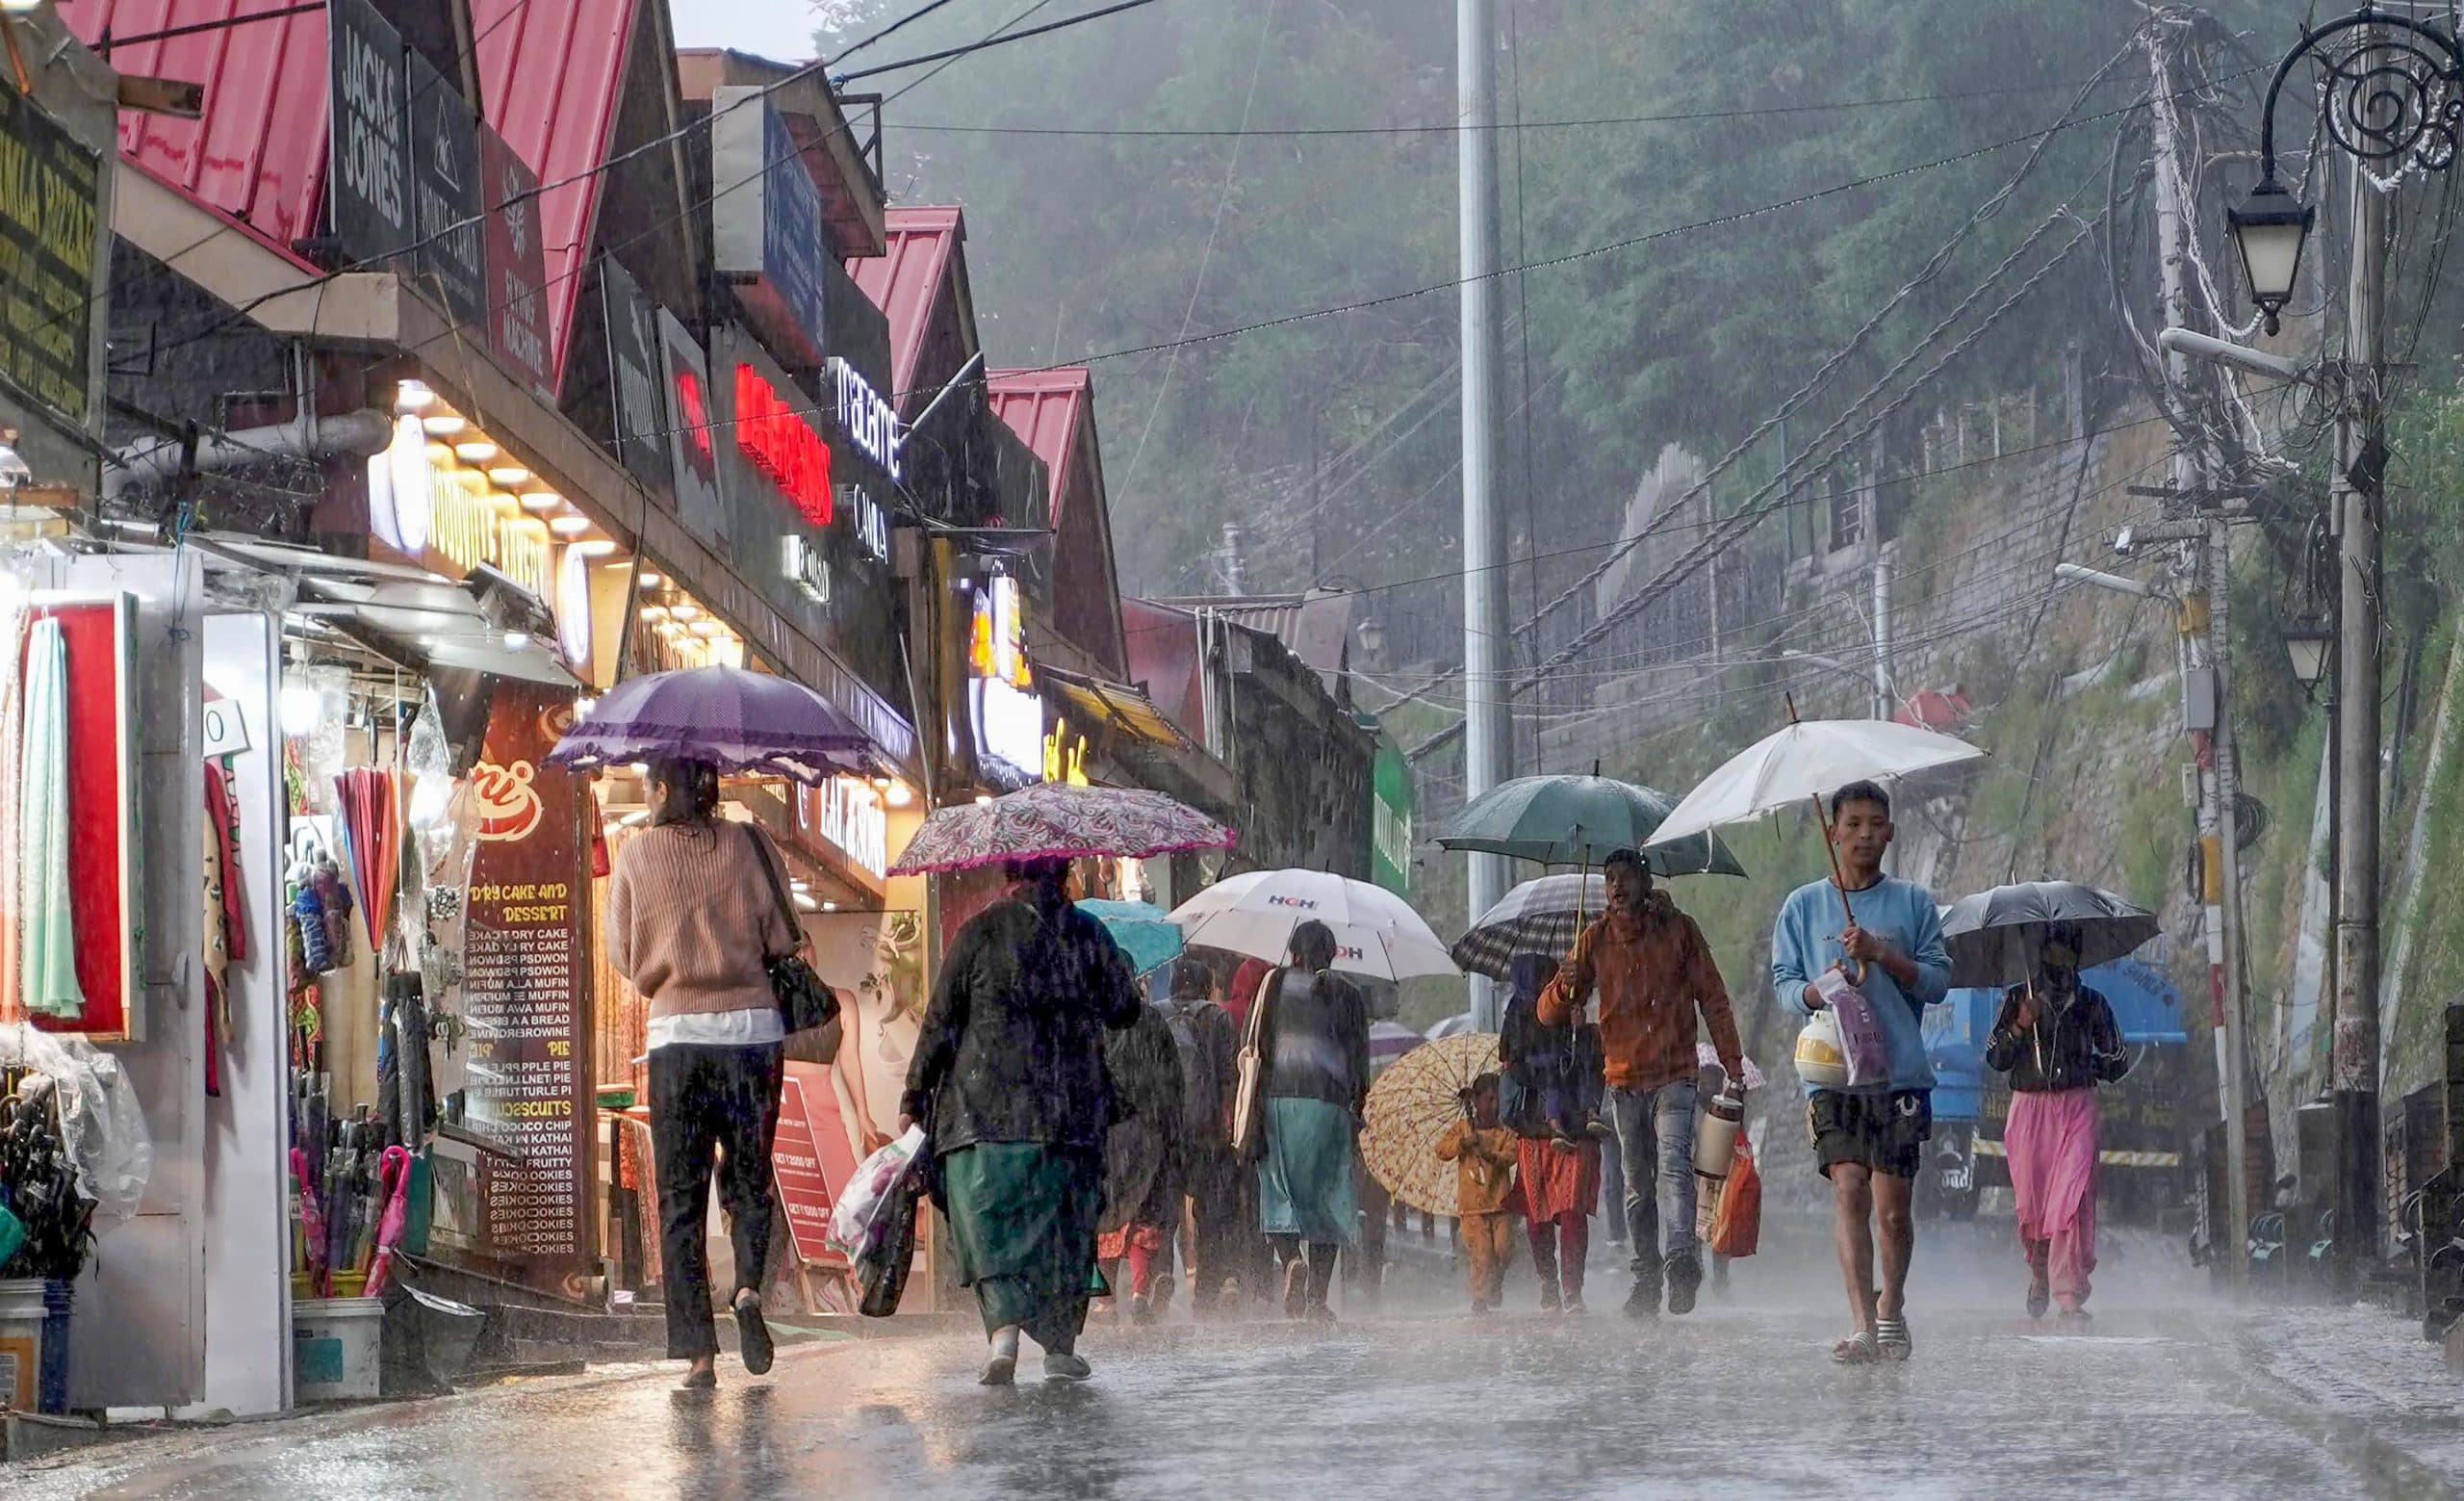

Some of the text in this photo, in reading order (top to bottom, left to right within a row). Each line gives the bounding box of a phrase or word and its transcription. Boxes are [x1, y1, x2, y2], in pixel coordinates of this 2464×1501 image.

[345, 110, 401, 229] JONES
[502, 309, 543, 377] MACHINE
[470, 883, 567, 901] DRY CAKE AND
[502, 905, 568, 922] DESSERT
[537, 928, 569, 939] CAKE
[537, 941, 569, 951] CAKE
[534, 978, 569, 988] MUFIN
[527, 990, 570, 1000] MUFFIN
[535, 1002, 570, 1013] MUFIN
[530, 1015, 570, 1025] BREAD
[547, 1040, 571, 1056] PIE
[521, 1061, 571, 1072] PPLE PIE
[522, 1074, 550, 1084] LNET
[553, 1073, 572, 1083] PIE
[521, 1100, 572, 1117] SCUITS
[545, 1121, 572, 1131] CHIP
[530, 1133, 572, 1144] KATHAI
[531, 1145, 572, 1155] KATHAI
